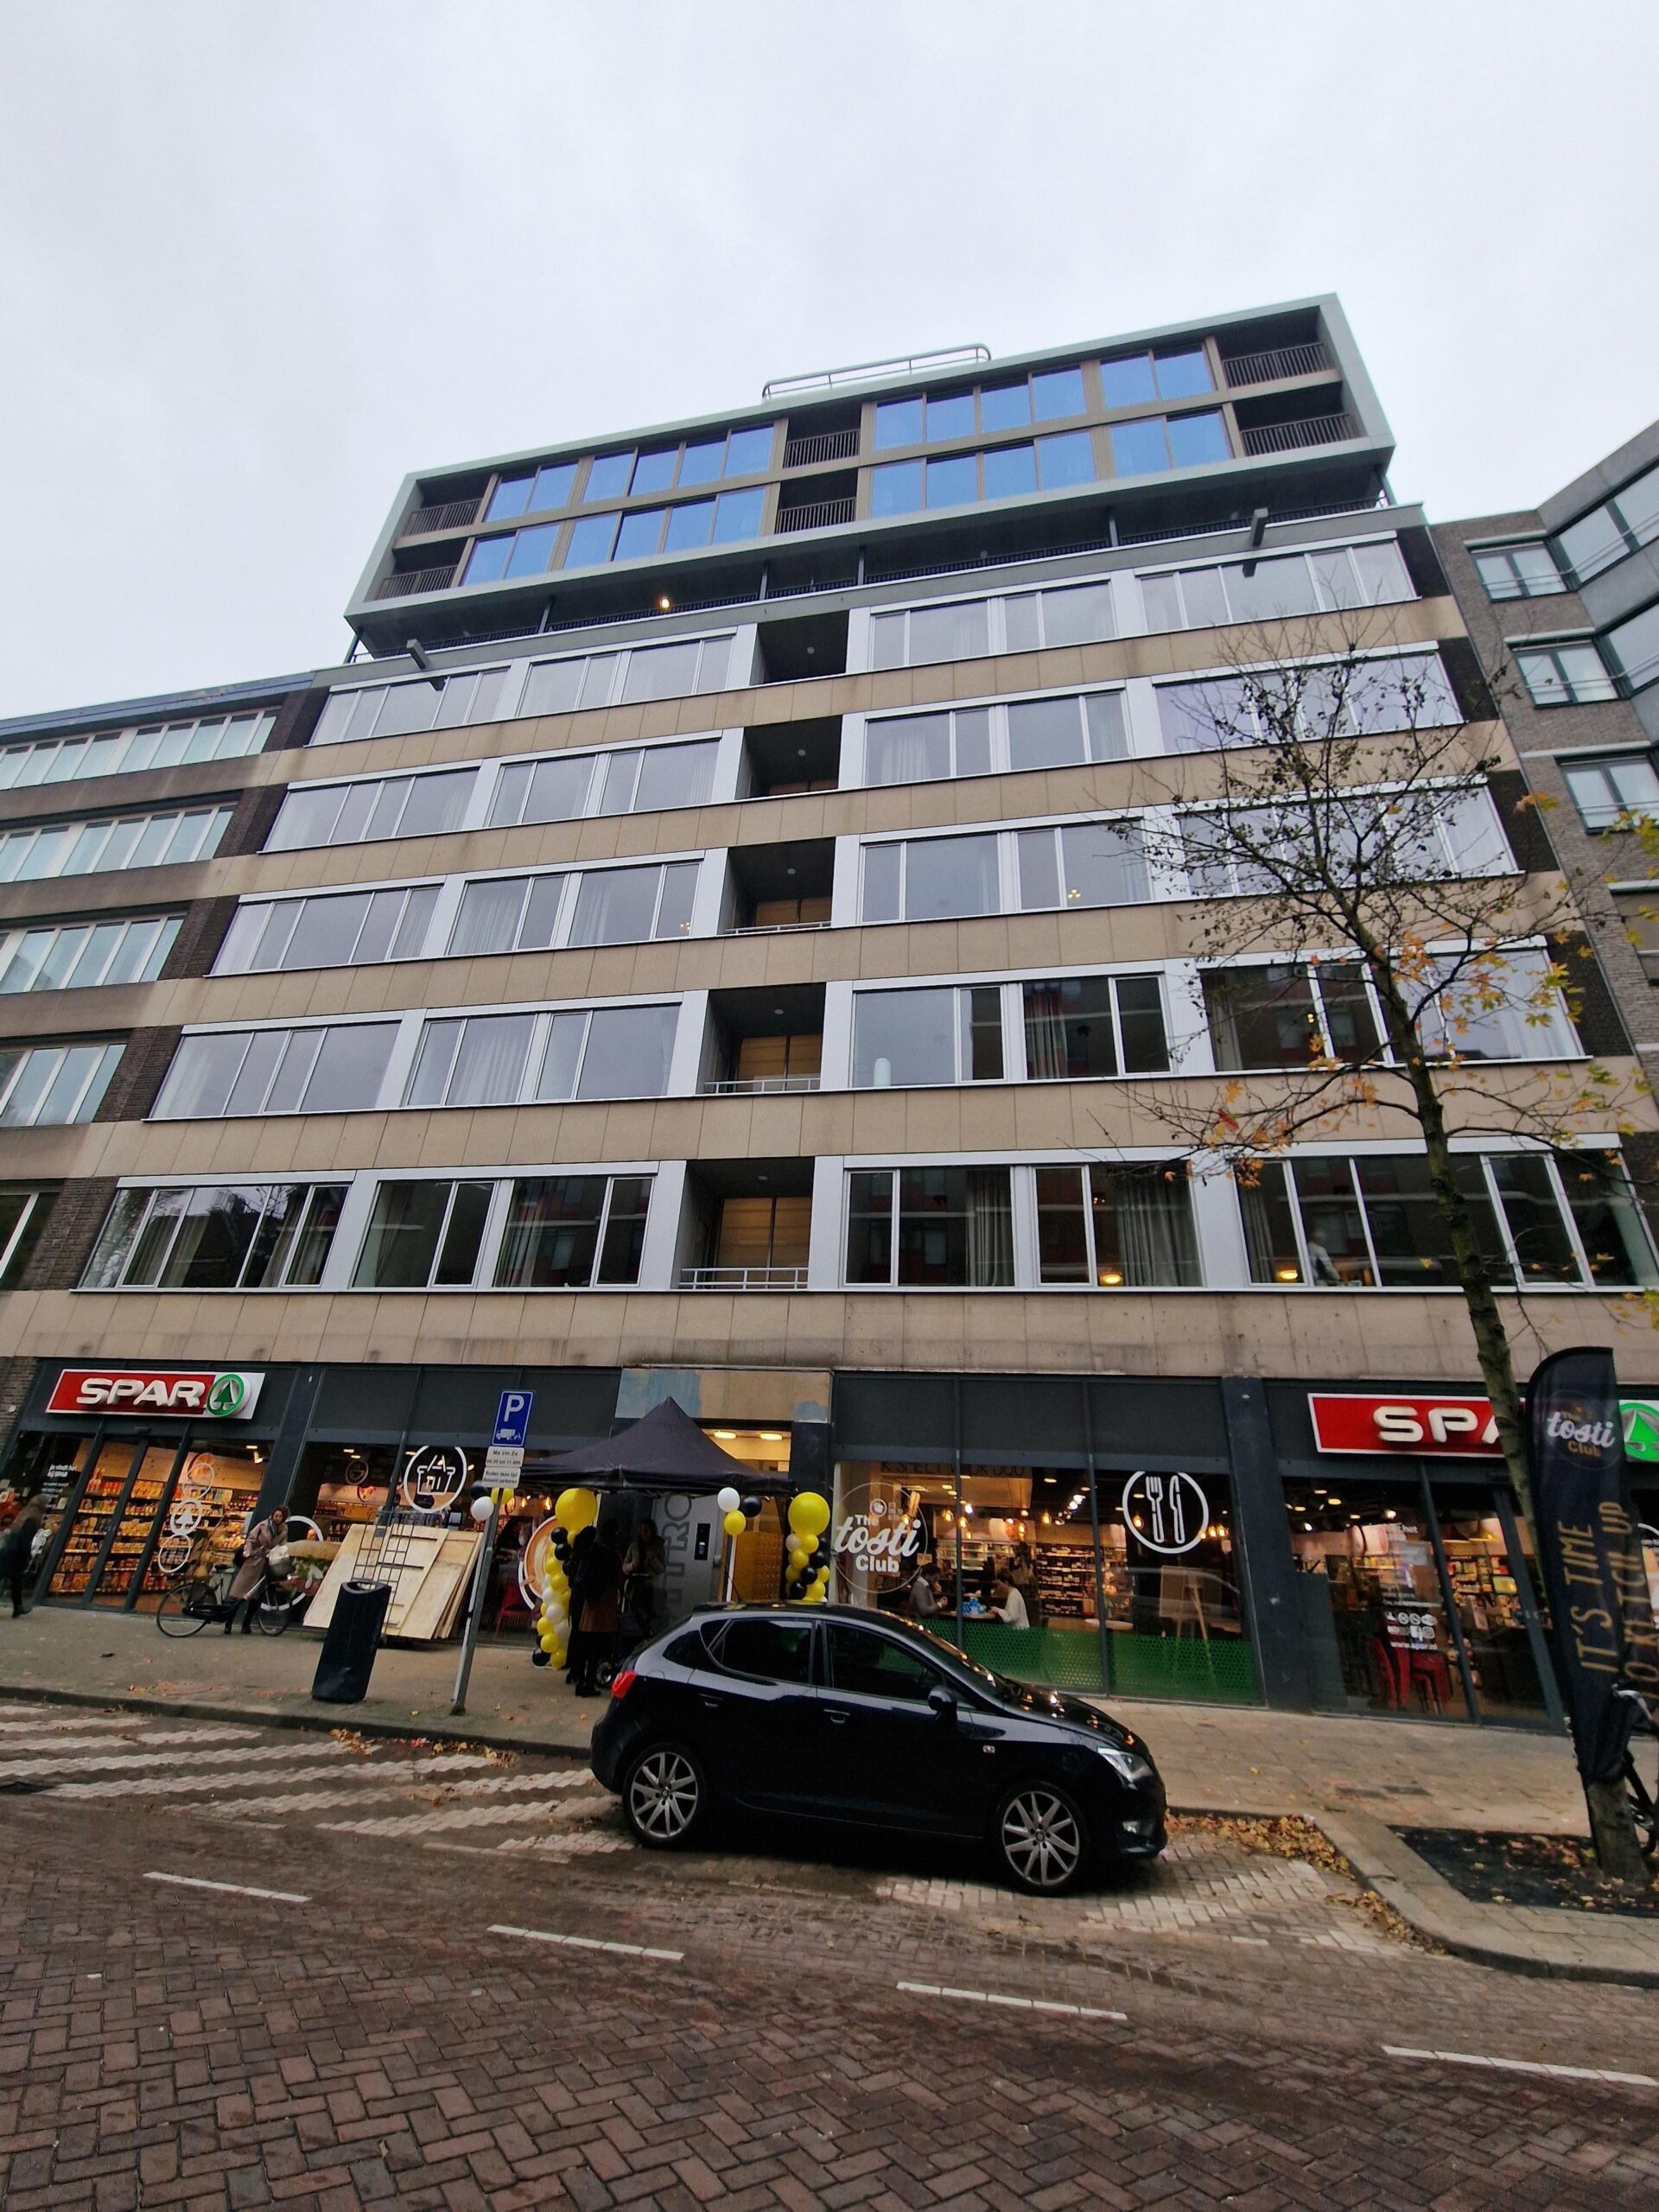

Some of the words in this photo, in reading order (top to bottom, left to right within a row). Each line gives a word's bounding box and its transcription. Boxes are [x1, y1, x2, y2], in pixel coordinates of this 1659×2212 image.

[76, 1378, 205, 1407] SPAR
[504, 1394, 524, 1422] P
[1373, 1405, 1500, 1444] SP
[1547, 1411, 1616, 1448] tosti
[1567, 1440, 1602, 1458] Club
[855, 1514, 880, 1526] The
[1599, 1501, 1633, 1535] UP
[834, 1516, 921, 1557] tosti
[1558, 1520, 1604, 1586] TIME
[855, 1554, 899, 1573] Club
[1570, 1606, 1619, 1673] IT'S
